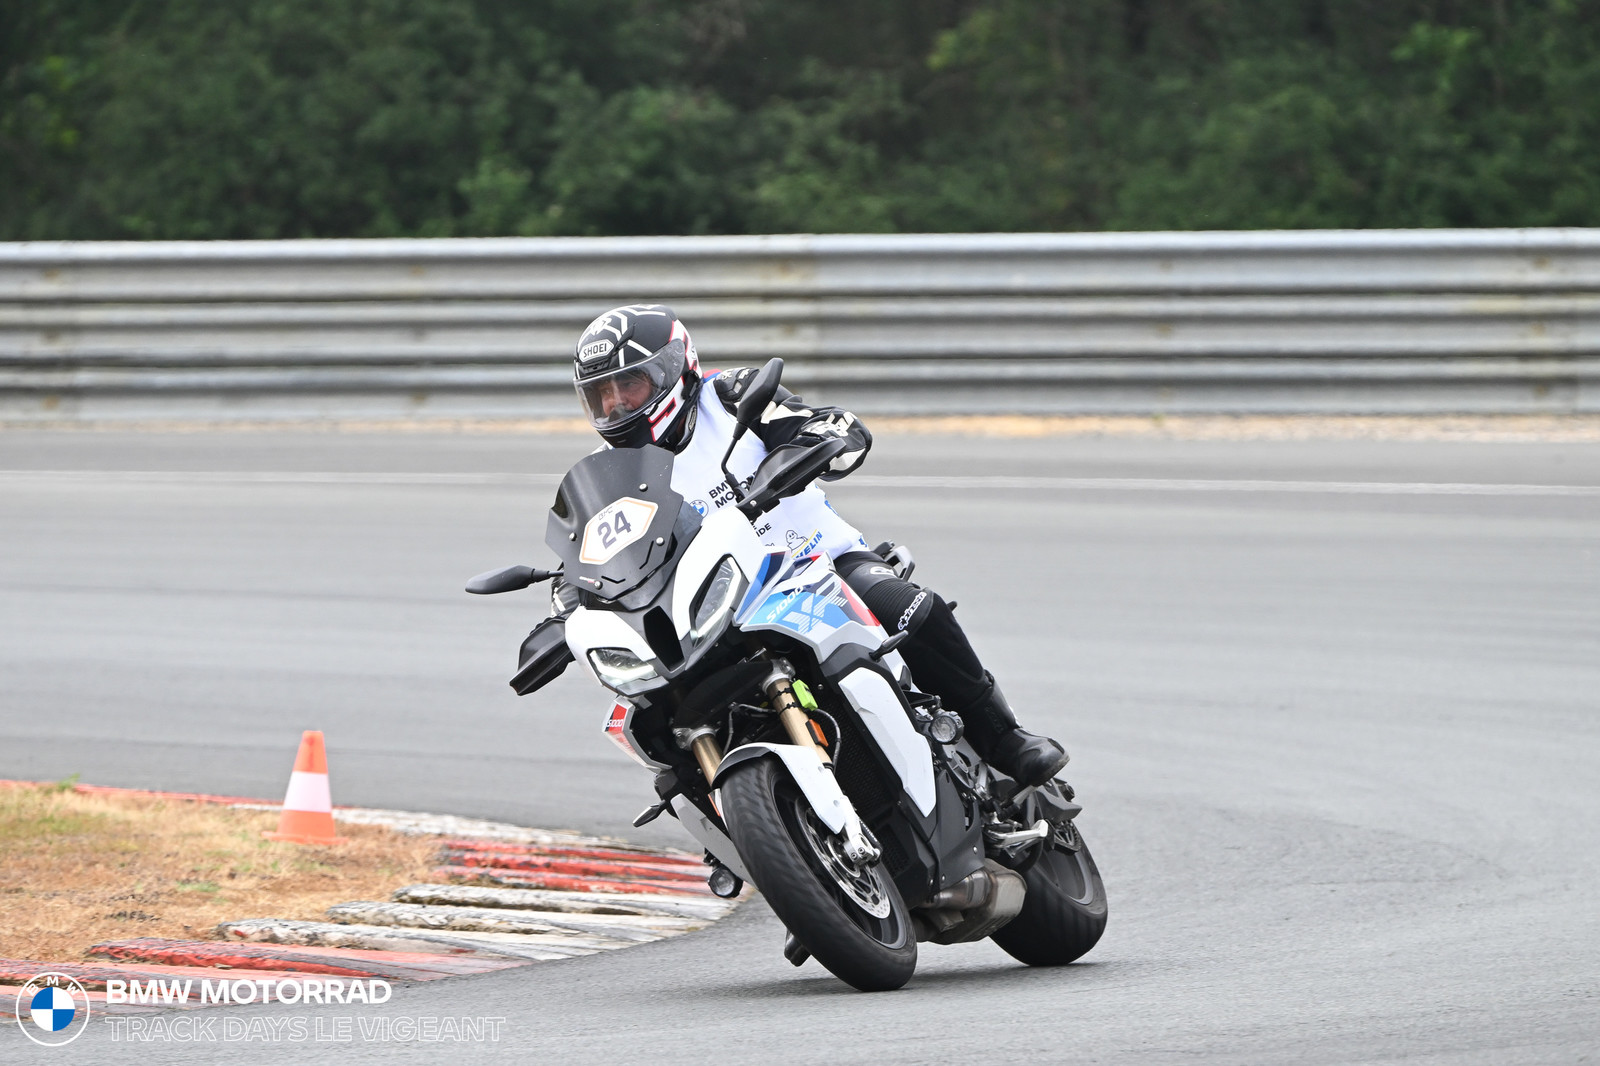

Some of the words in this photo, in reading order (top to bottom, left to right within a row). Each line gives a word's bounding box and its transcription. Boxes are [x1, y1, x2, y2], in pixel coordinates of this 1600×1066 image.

[583, 343, 607, 358] SHOEI
[708, 480, 729, 499] BM
[597, 510, 632, 550] 24
[755, 522, 772, 538] IDE
[766, 585, 804, 624] S1000
